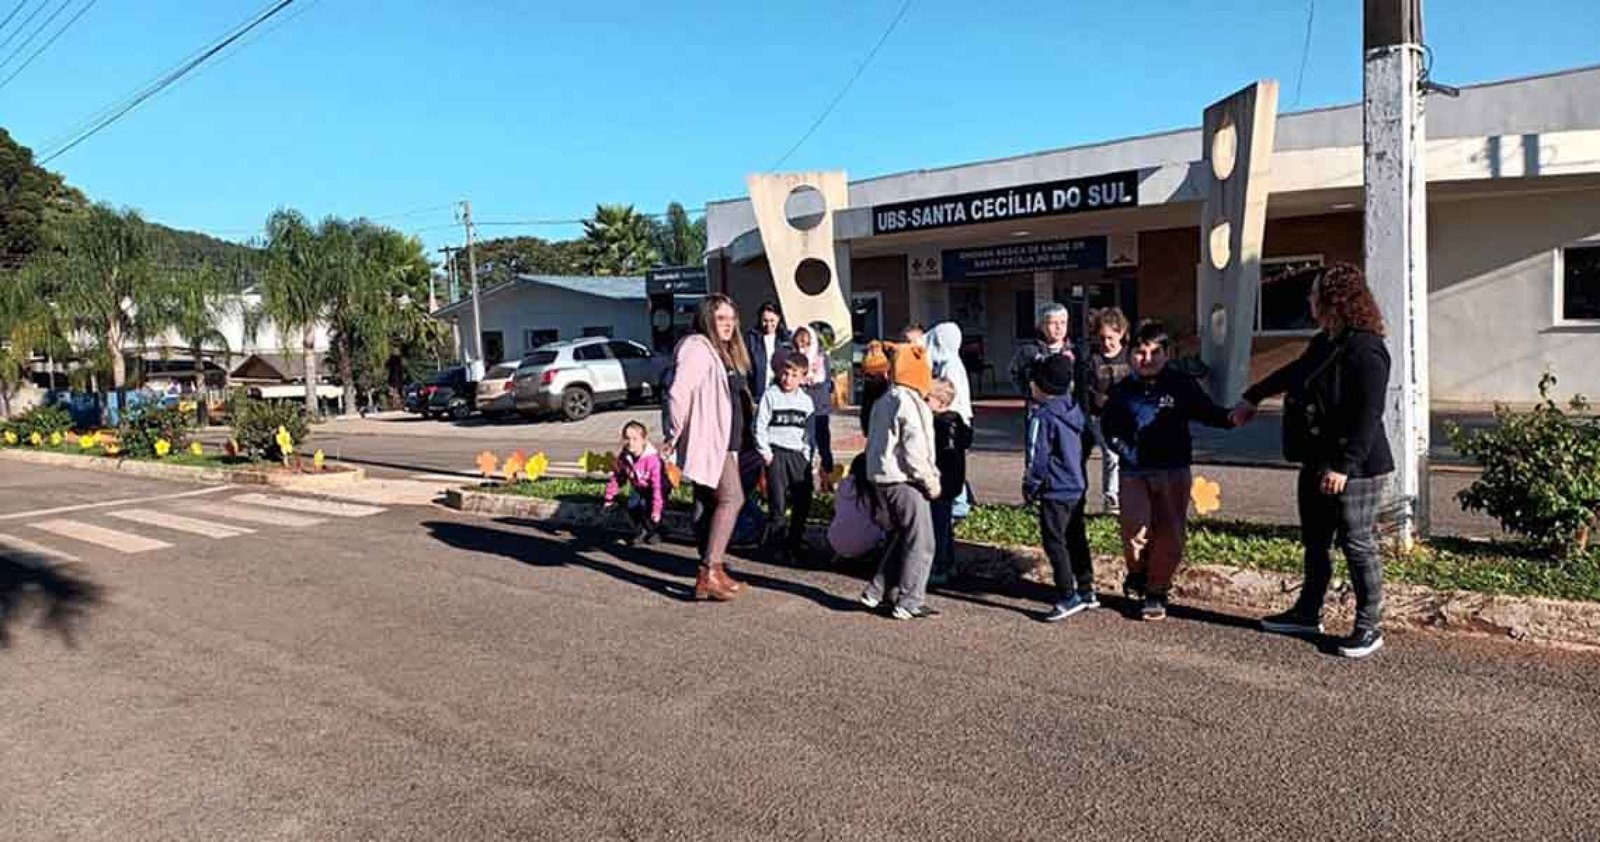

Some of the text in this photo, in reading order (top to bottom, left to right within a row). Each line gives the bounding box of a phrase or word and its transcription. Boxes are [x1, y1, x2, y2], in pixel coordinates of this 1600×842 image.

[878, 182, 1133, 231] UBS-SANTA CECÍLIA DO SUL
